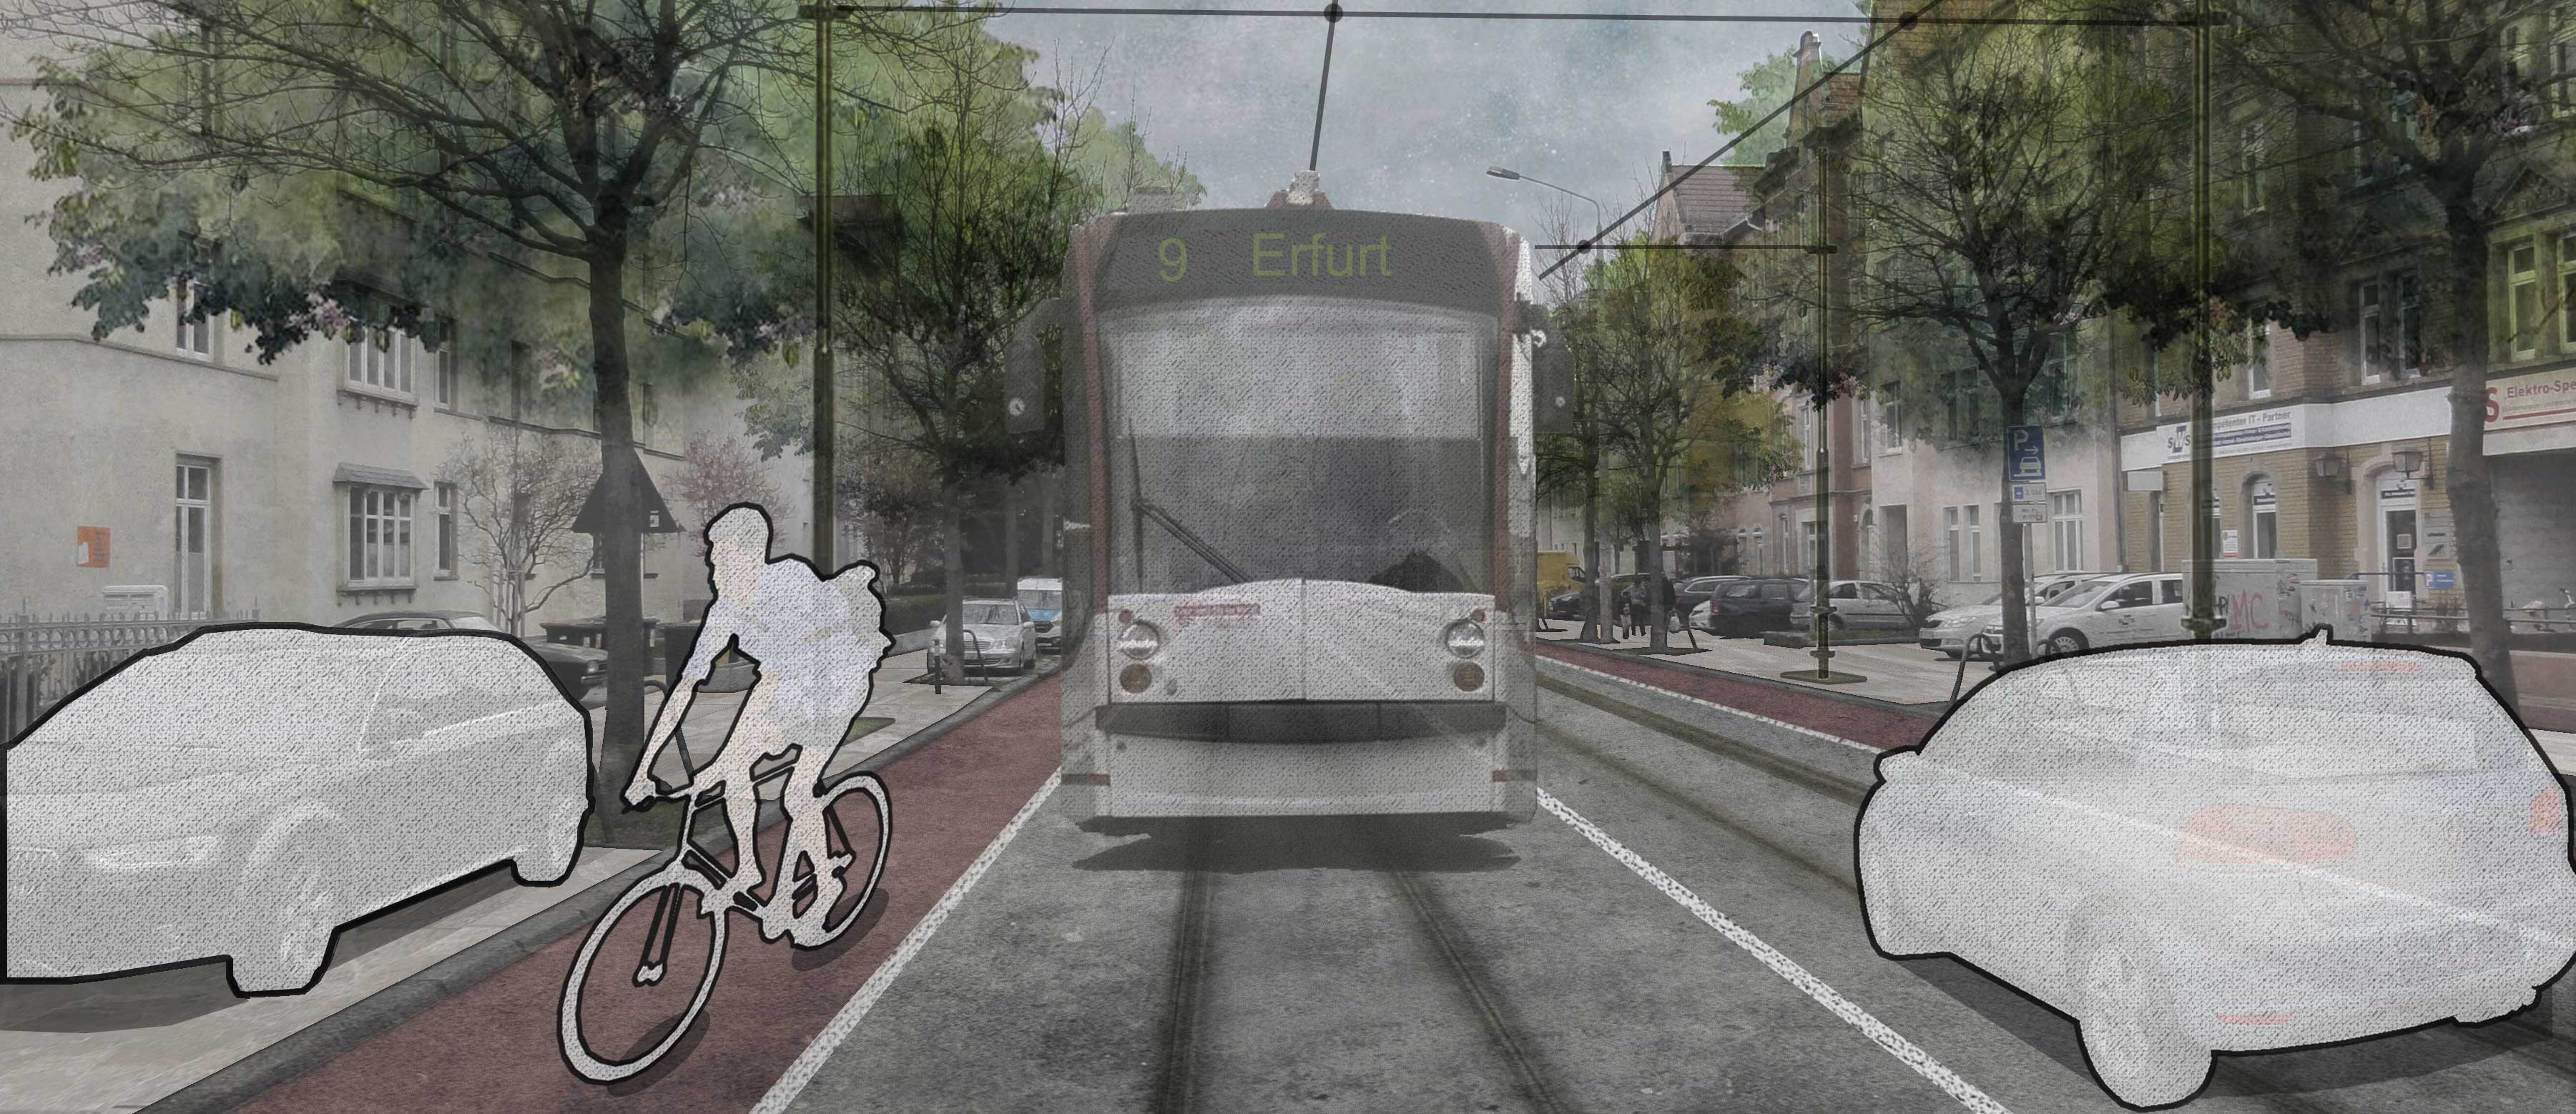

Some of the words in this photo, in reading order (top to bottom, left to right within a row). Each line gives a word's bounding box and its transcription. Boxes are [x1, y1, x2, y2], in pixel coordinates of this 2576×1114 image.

[1159, 238, 1188, 282] 9
[1253, 232, 1392, 277] Erfurt
[2262, 411, 2291, 423] Partner
[2014, 430, 2029, 451] P
